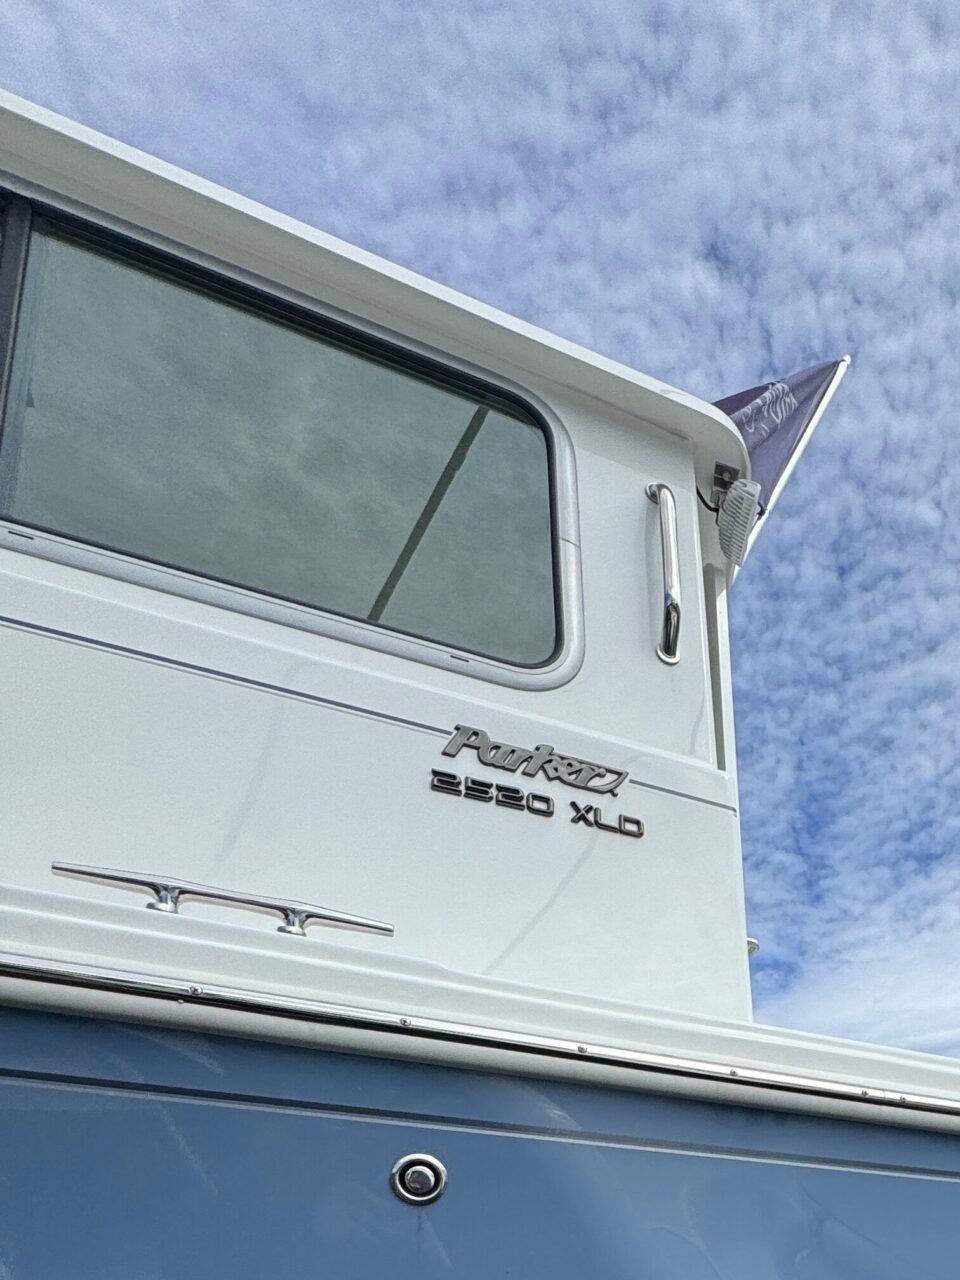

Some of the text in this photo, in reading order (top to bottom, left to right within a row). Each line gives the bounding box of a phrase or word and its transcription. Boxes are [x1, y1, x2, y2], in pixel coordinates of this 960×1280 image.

[441, 723, 629, 796] Parker
[431, 767, 644, 838] 2520 XLD
